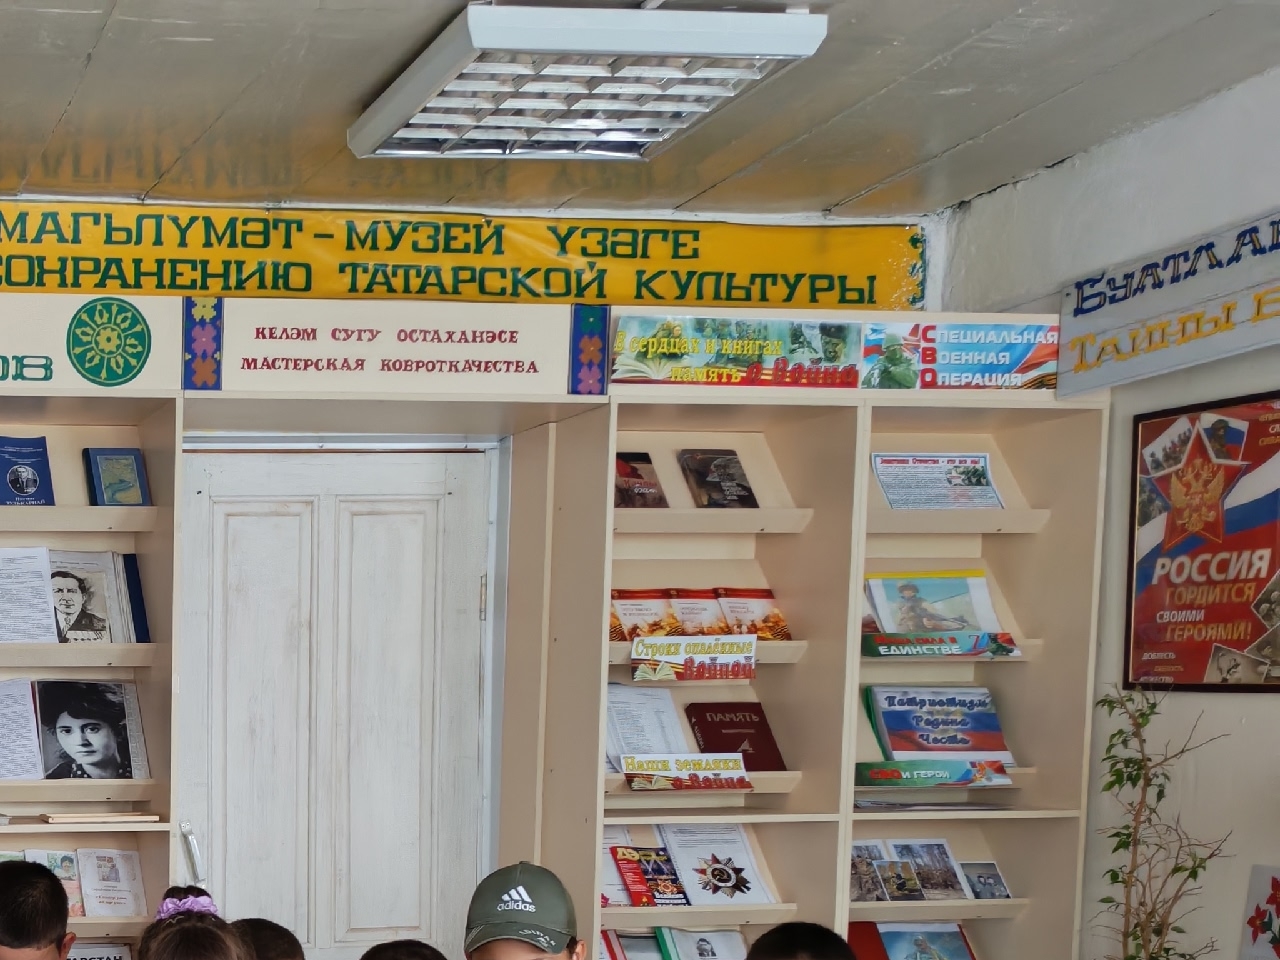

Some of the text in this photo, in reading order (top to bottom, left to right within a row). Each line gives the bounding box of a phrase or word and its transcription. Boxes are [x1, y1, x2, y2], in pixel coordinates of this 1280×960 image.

[338, 261, 608, 299] ТАТАРСКОЙ
[634, 269, 877, 305] КУЛЬТУРЫ
[254, 327, 318, 341] КЕЛӘМ
[330, 328, 382, 342] СУГУ
[922, 324, 1058, 345] СПЕЦИАЛЬНАЯ
[631, 337, 699, 360] сердцах
[705, 340, 718, 352] и
[721, 340, 783, 355] книгах
[922, 347, 1011, 365] ВОЕННАЯ
[240, 357, 539, 374] МАСТЕРСКАЯ КОВРОТКАЧЕСТВА
[670, 367, 742, 383] память
[922, 368, 1022, 388] ОПЕРАЦИЯ
[1151, 547, 1272, 585] РОССИЯ
[1166, 583, 1256, 608] ГОРДИТСЯ
[1156, 609, 1205, 623] СВОИМИ
[1165, 622, 1252, 641] ГЕРОЯМИ!
[634, 640, 681, 656] Строки
[879, 645, 962, 654] ЕДИНСТВЕ
[706, 712, 759, 722] ПАМЯТЬ
[497, 901, 536, 912] adidas
